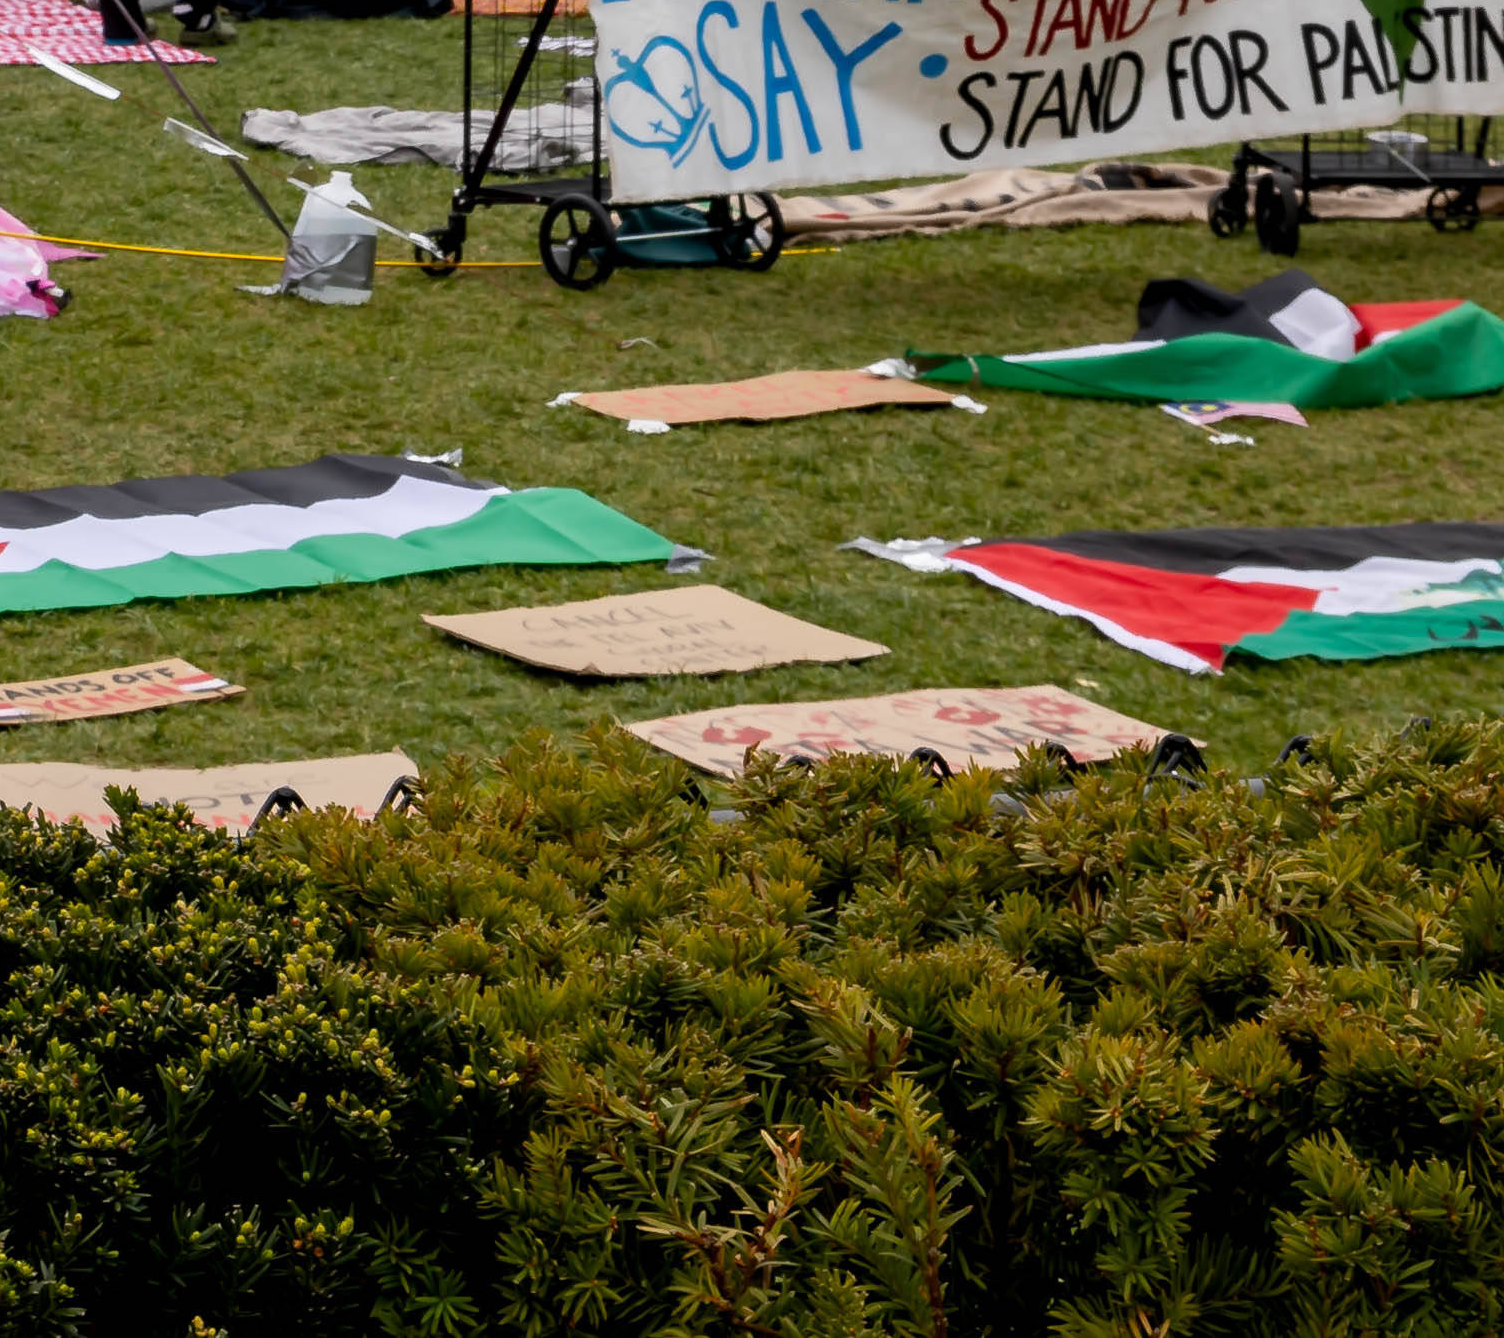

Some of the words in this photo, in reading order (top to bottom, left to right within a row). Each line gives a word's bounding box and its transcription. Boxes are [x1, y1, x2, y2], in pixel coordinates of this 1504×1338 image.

[939, 50, 1146, 161] STAND
[1166, 29, 1291, 121] FOR
[1300, 6, 1504, 106] PALSTIN
[112, 666, 176, 685] OFF
[22, 682, 185, 715] YEMEN
